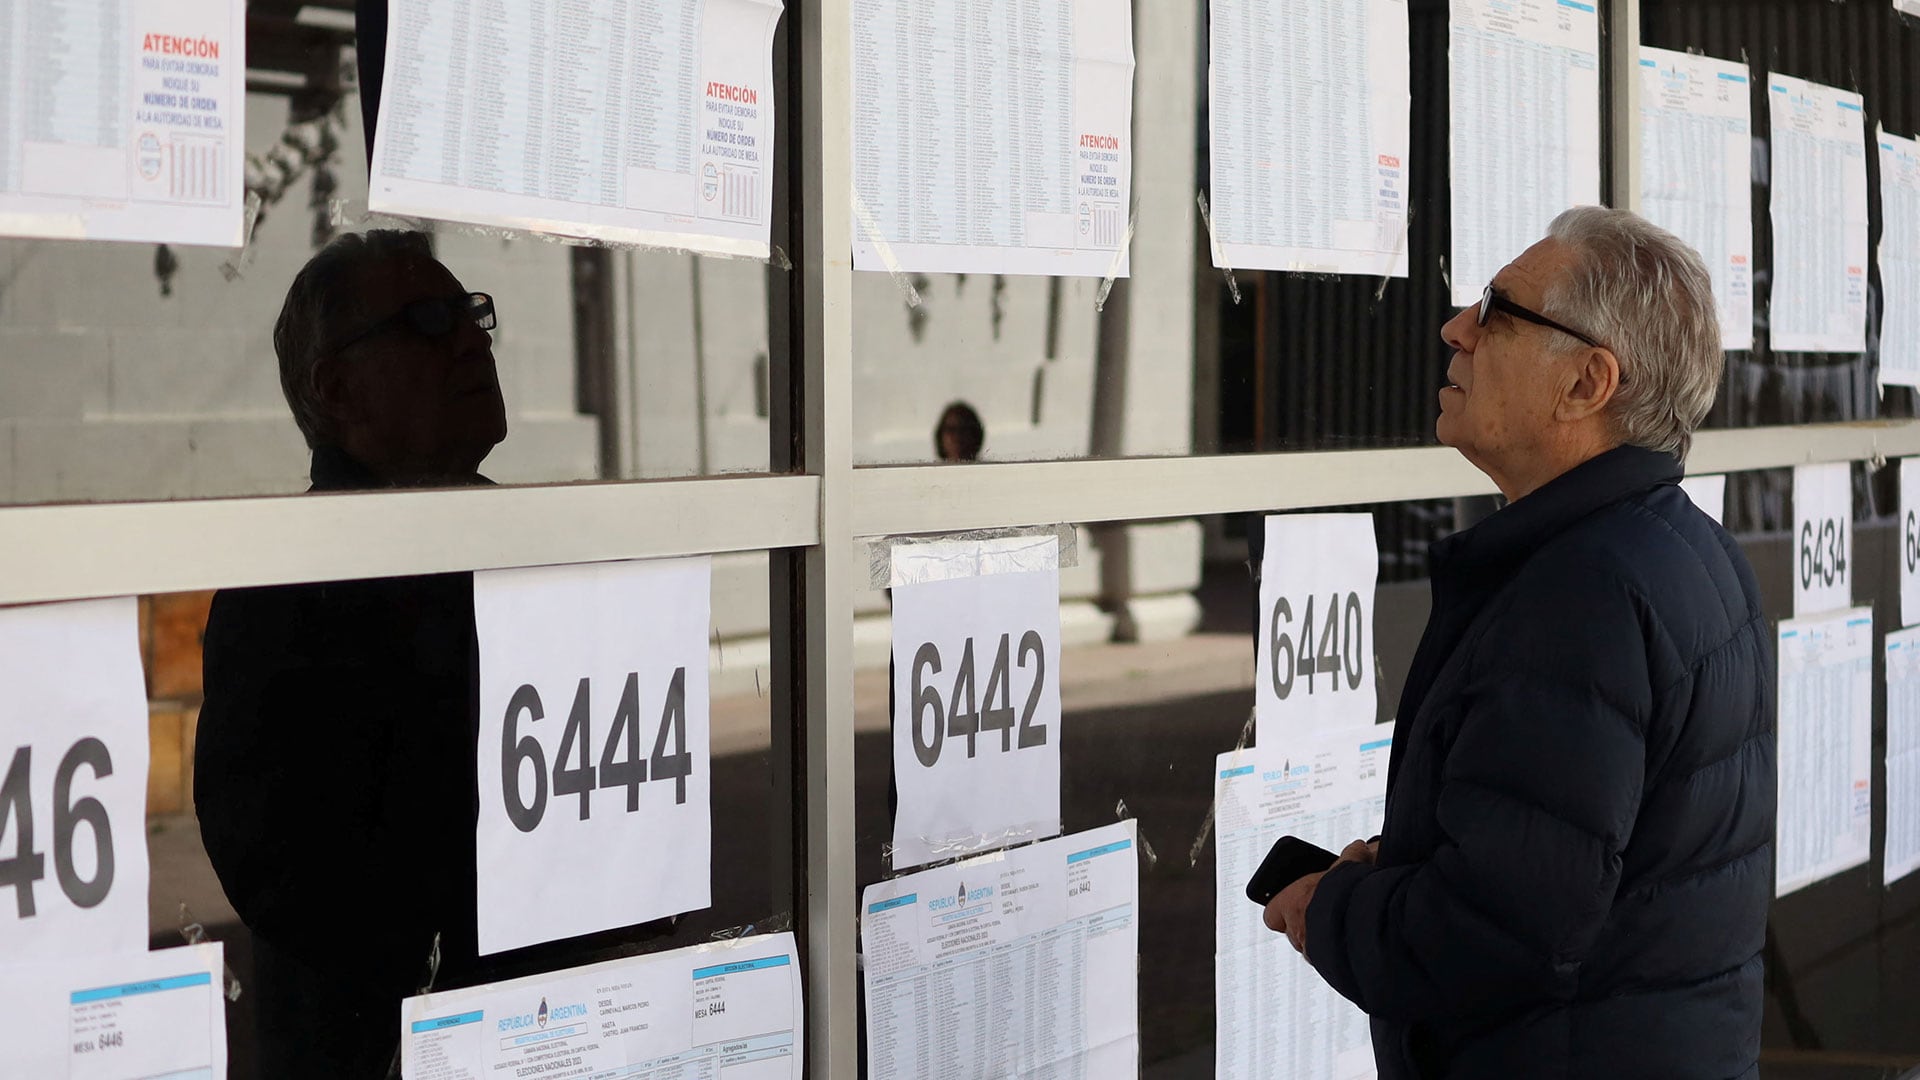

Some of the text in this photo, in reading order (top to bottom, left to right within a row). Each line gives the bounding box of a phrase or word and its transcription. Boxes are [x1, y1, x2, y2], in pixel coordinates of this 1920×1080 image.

[143, 33, 219, 59] ATENCIÓN
[179, 95, 188, 108] DE
[706, 82, 757, 104] ATENCIÓN
[729, 134, 736, 144] DE
[737, 136, 755, 147] ORDEN
[1080, 134, 1118, 150] ATENCIÓN
[1801, 517, 1846, 590] 6434
[1270, 591, 1362, 700] 6440
[911, 630, 1047, 768] 6442
[502, 667, 692, 833] 6444
[0, 736, 114, 919] 46
[1080, 880, 1090, 894] 6442
[550, 1003, 588, 1021] ARGENTINA
[695, 1001, 725, 1018] MESA 6444
[74, 1031, 122, 1054] MESA 6446
[544, 1058, 572, 1072] NACIONALES
